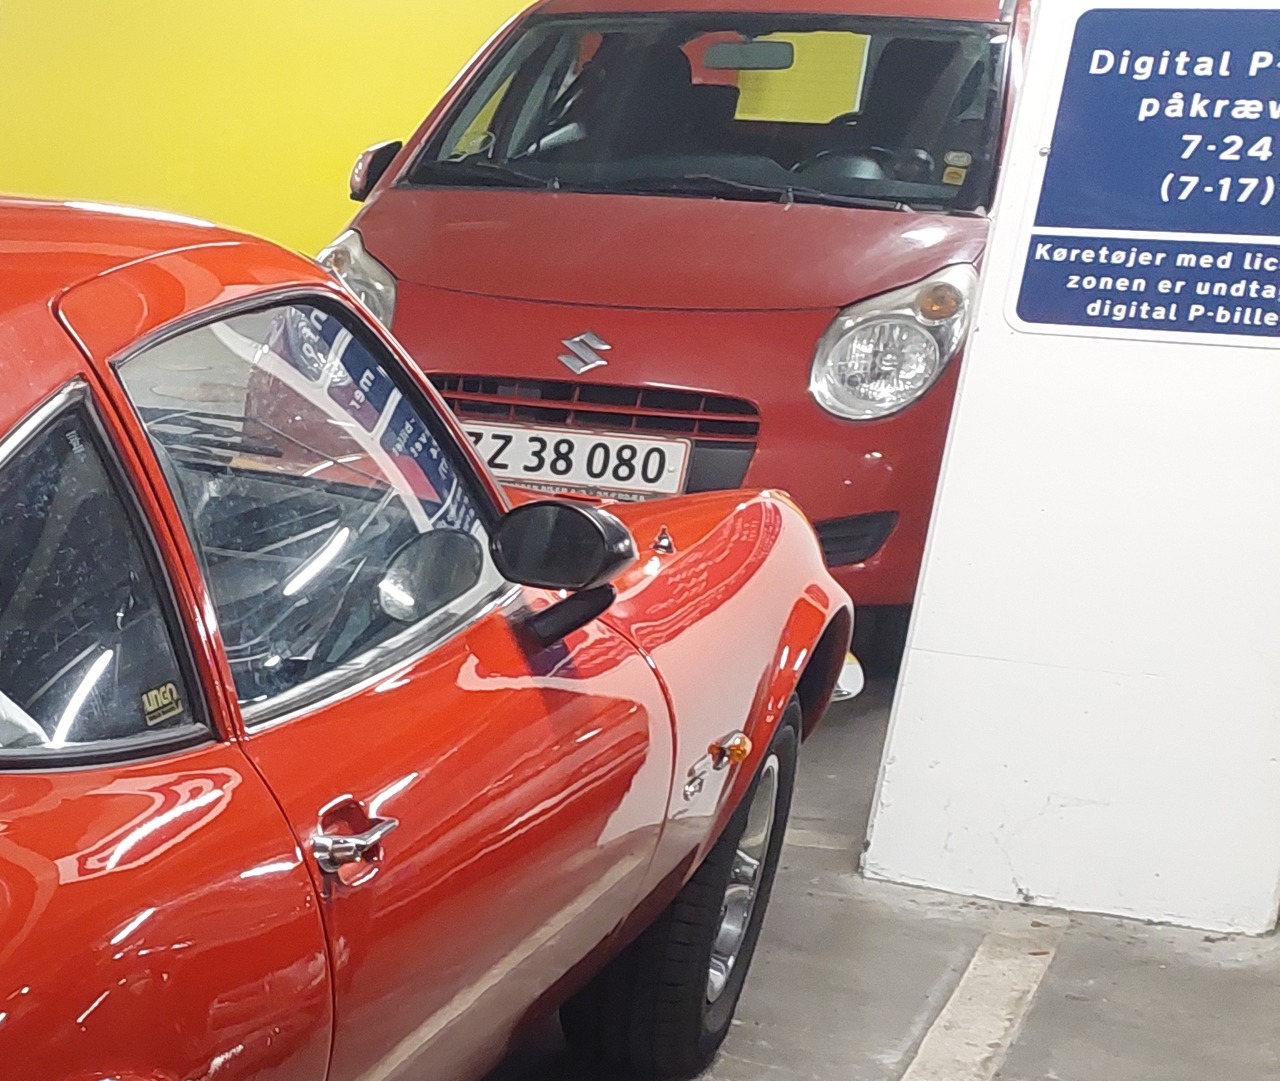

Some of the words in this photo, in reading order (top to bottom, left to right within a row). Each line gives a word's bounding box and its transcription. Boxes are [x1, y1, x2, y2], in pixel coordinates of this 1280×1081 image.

[1089, 49, 1231, 80] Digital
[1138, 92, 1280, 121] påkræv
[1180, 134, 1273, 161] 7-24
[1160, 173, 1275, 206] (7-17)
[1035, 243, 1167, 269] Køretøjer
[1176, 251, 1233, 269] med
[1066, 274, 1146, 292] zonen
[1158, 280, 1186, 294] er
[1196, 279, 1280, 302] undta
[1086, 300, 1177, 321] digital
[1188, 304, 1279, 327] P-bille
[523, 436, 574, 475] 38
[586, 442, 666, 483] 080
